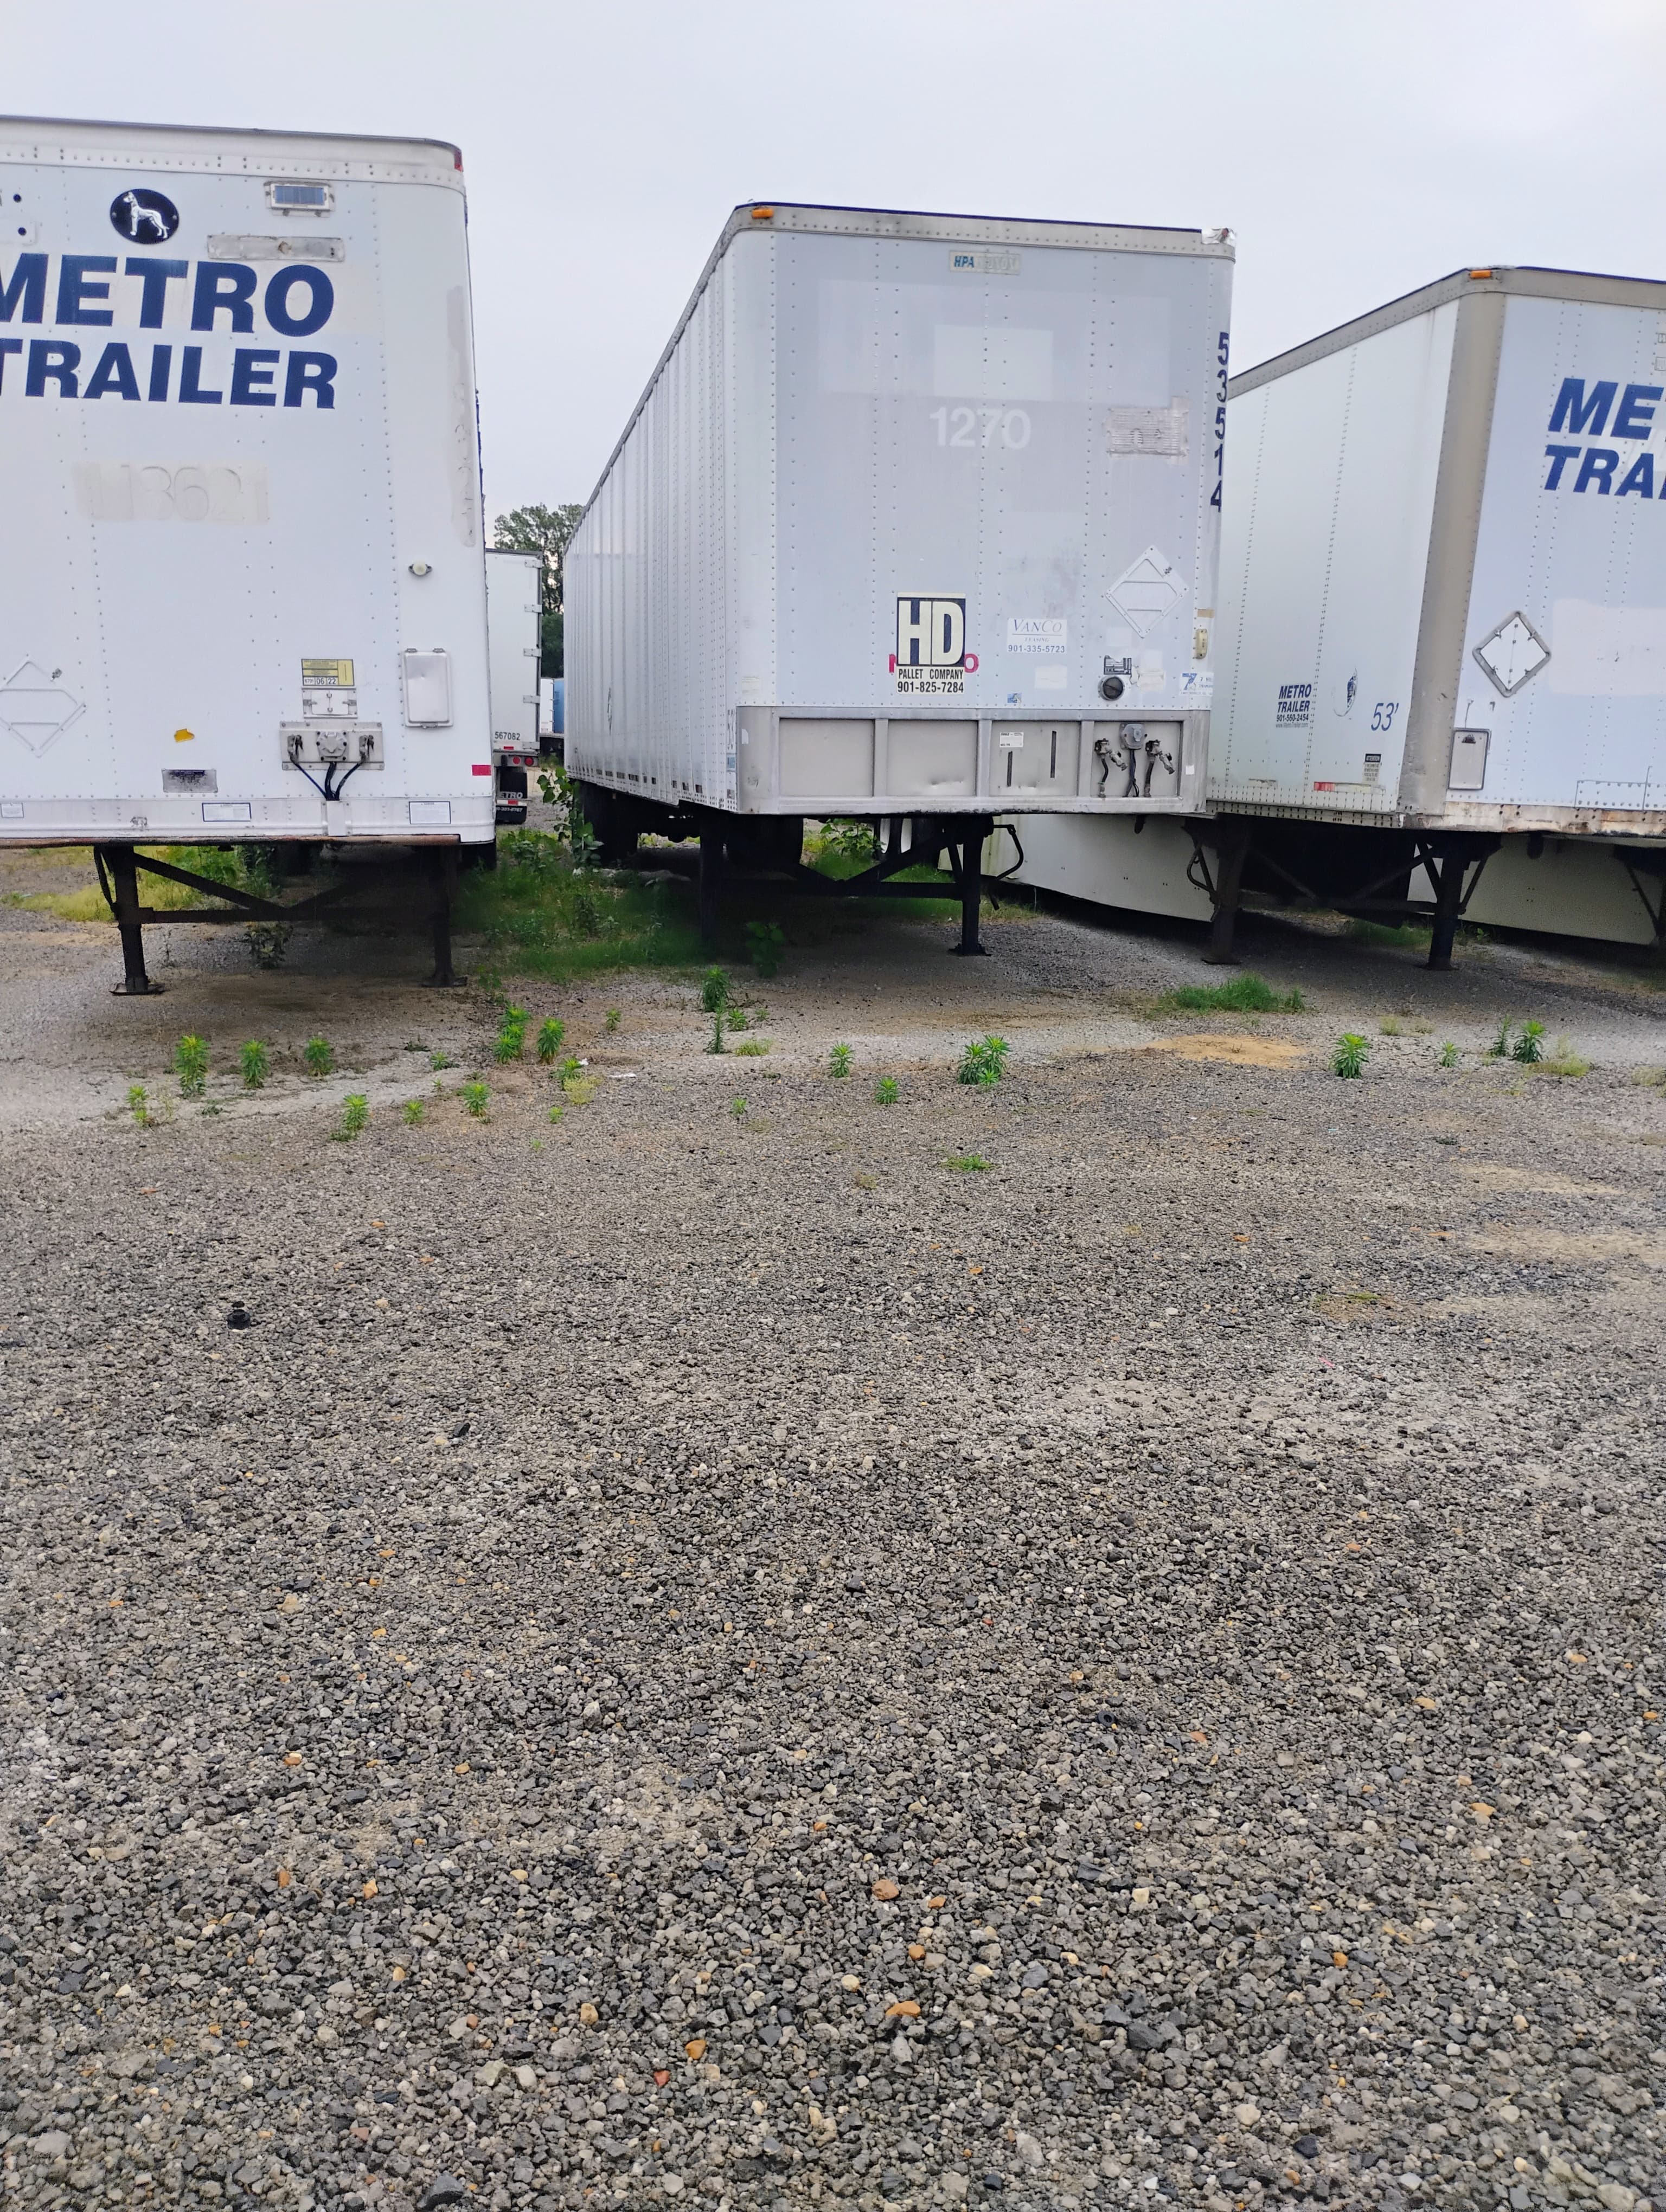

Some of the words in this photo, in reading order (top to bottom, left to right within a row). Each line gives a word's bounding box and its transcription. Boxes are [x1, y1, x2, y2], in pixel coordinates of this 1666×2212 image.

[954, 255, 975, 268] HPA
[0, 252, 335, 337] METRO
[1548, 377, 1666, 443] ME
[929, 406, 1031, 449] 1270
[1210, 332, 1229, 513] 53514
[1544, 444, 1666, 500] TRA
[898, 600, 964, 665] HD
[1008, 644, 1066, 653] 901-335-5723
[898, 668, 924, 679] PALLET
[930, 668, 964, 680] COMPANY
[898, 681, 964, 693] 901-825-7284
[1278, 684, 1312, 699] METRO
[1278, 700, 1310, 713] TRAILER
[1276, 713, 1309, 722] 901-560-2454
[1370, 703, 1399, 731] 53'
[494, 731, 521, 741] 567082
